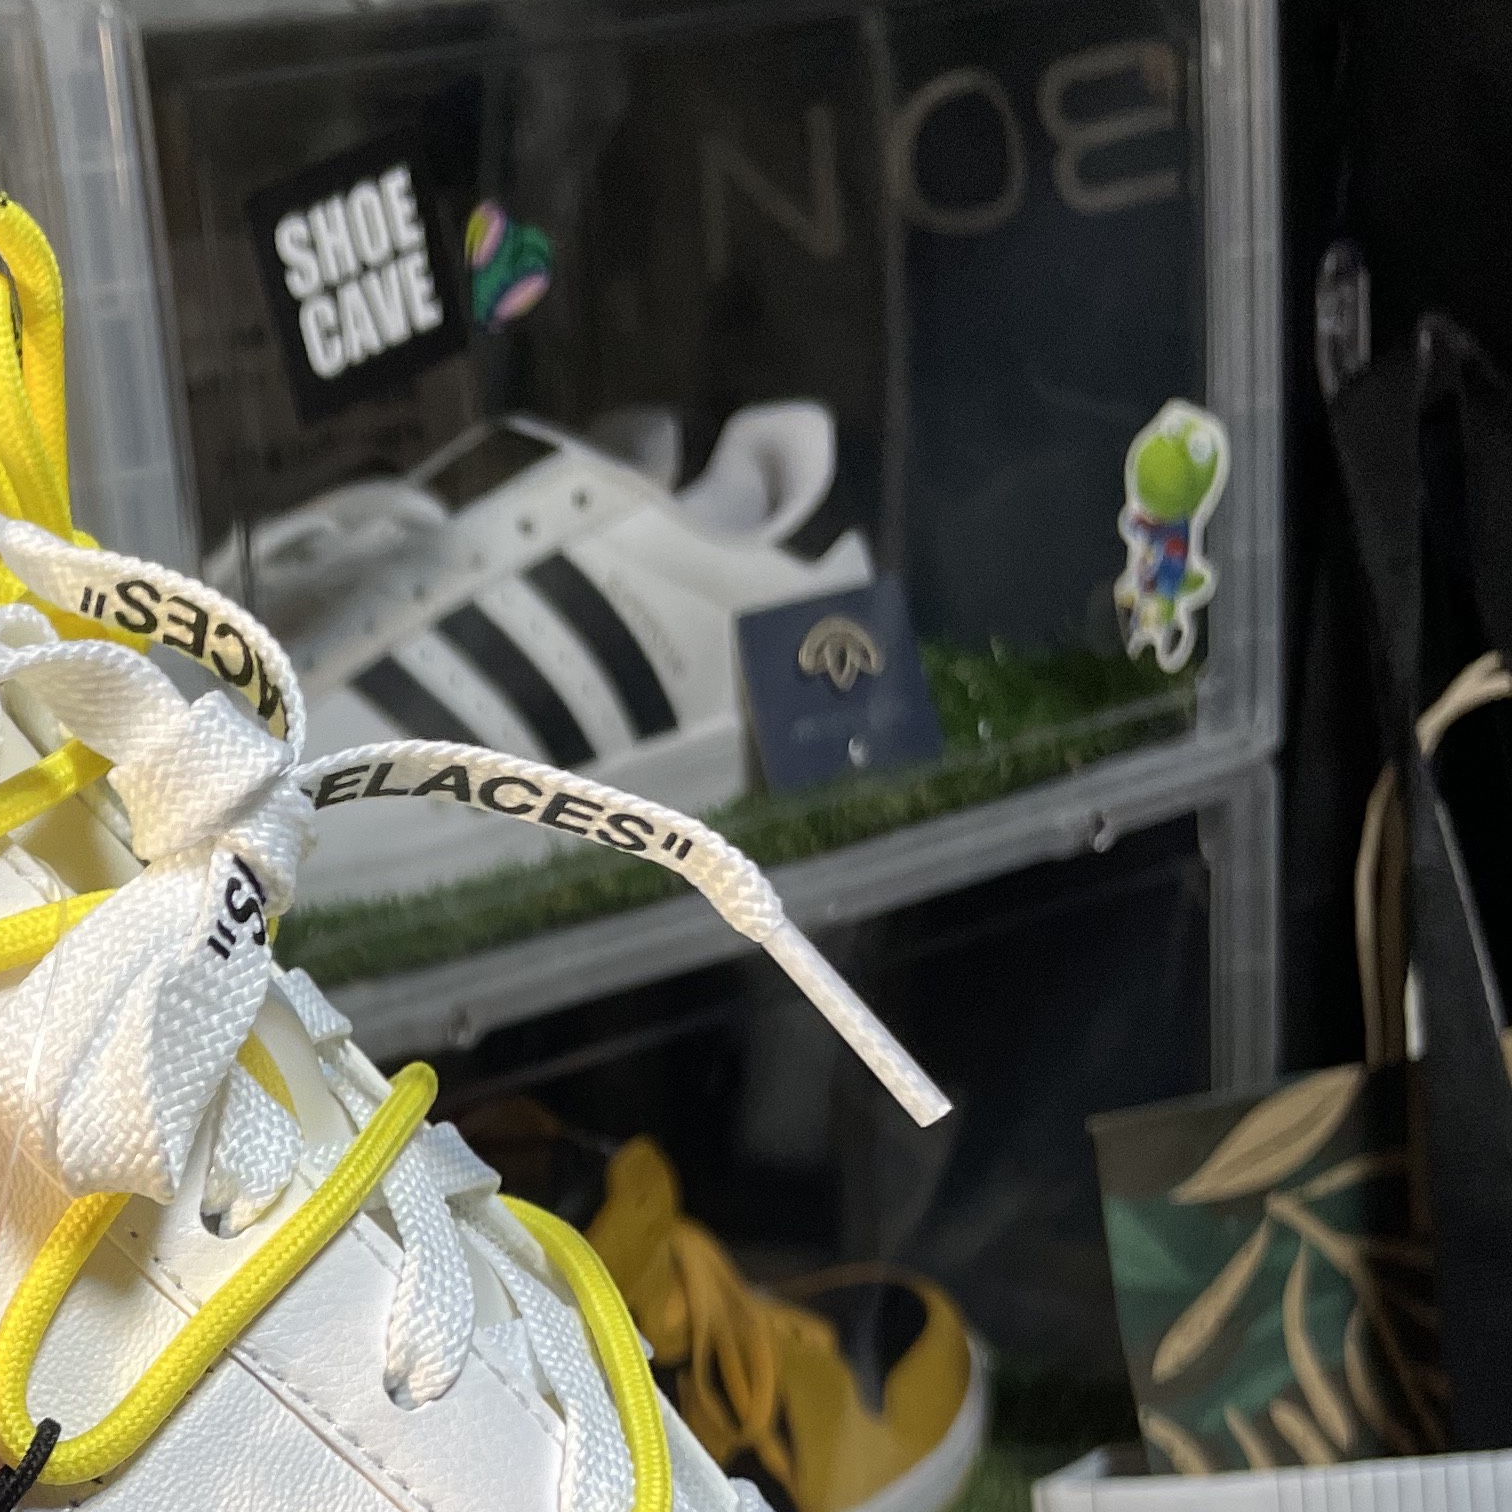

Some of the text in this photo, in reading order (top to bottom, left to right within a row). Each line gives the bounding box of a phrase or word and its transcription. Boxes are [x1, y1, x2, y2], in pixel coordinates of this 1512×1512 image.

[274, 165, 427, 300] SHOE
[299, 262, 444, 380] CAVE
[79, 579, 289, 741] ACES"
[301, 762, 693, 861] ELACES"
